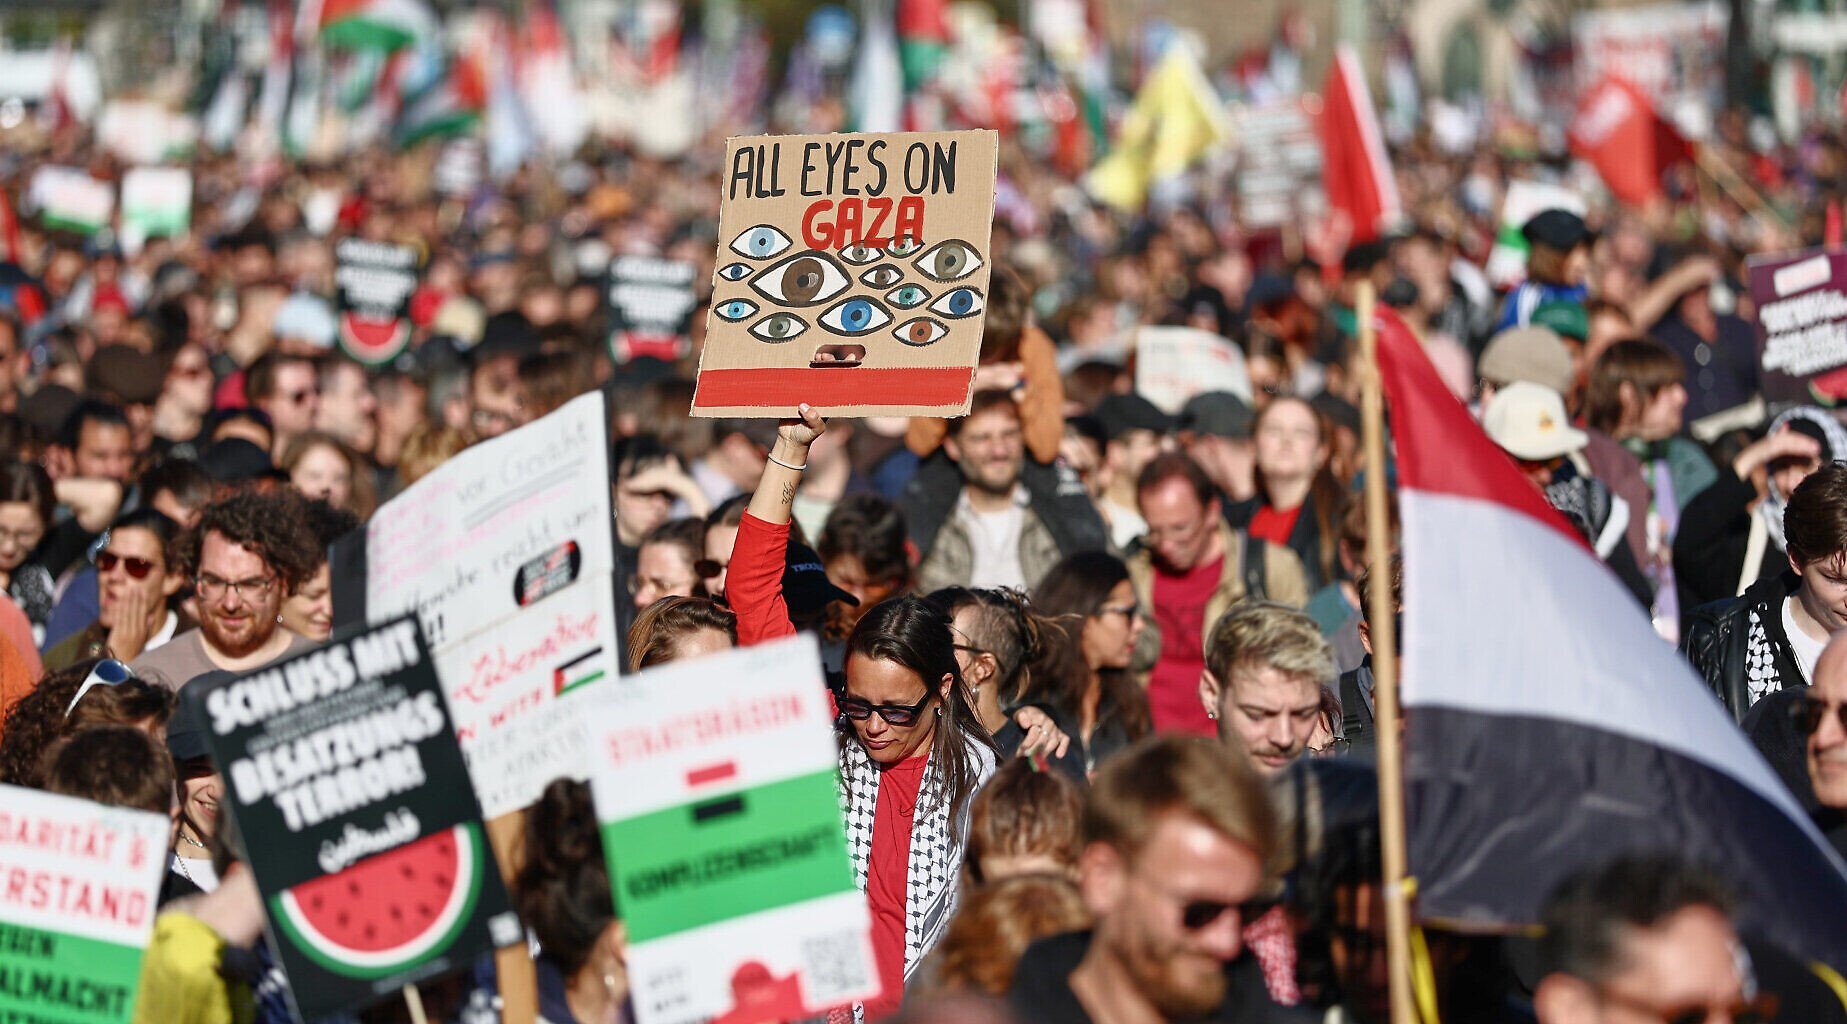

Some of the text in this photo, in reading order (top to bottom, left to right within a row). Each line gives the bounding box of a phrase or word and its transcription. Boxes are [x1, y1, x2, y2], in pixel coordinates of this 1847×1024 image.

[729, 139, 958, 200] ALL EYES ON
[801, 195, 926, 250] GAZA
[206, 642, 358, 736] SCHLUSS
[350, 617, 423, 681] MIT
[229, 689, 445, 806] BESATZUNGS
[606, 691, 807, 764] STAATSRÄSON
[273, 742, 427, 833] TERROR!
